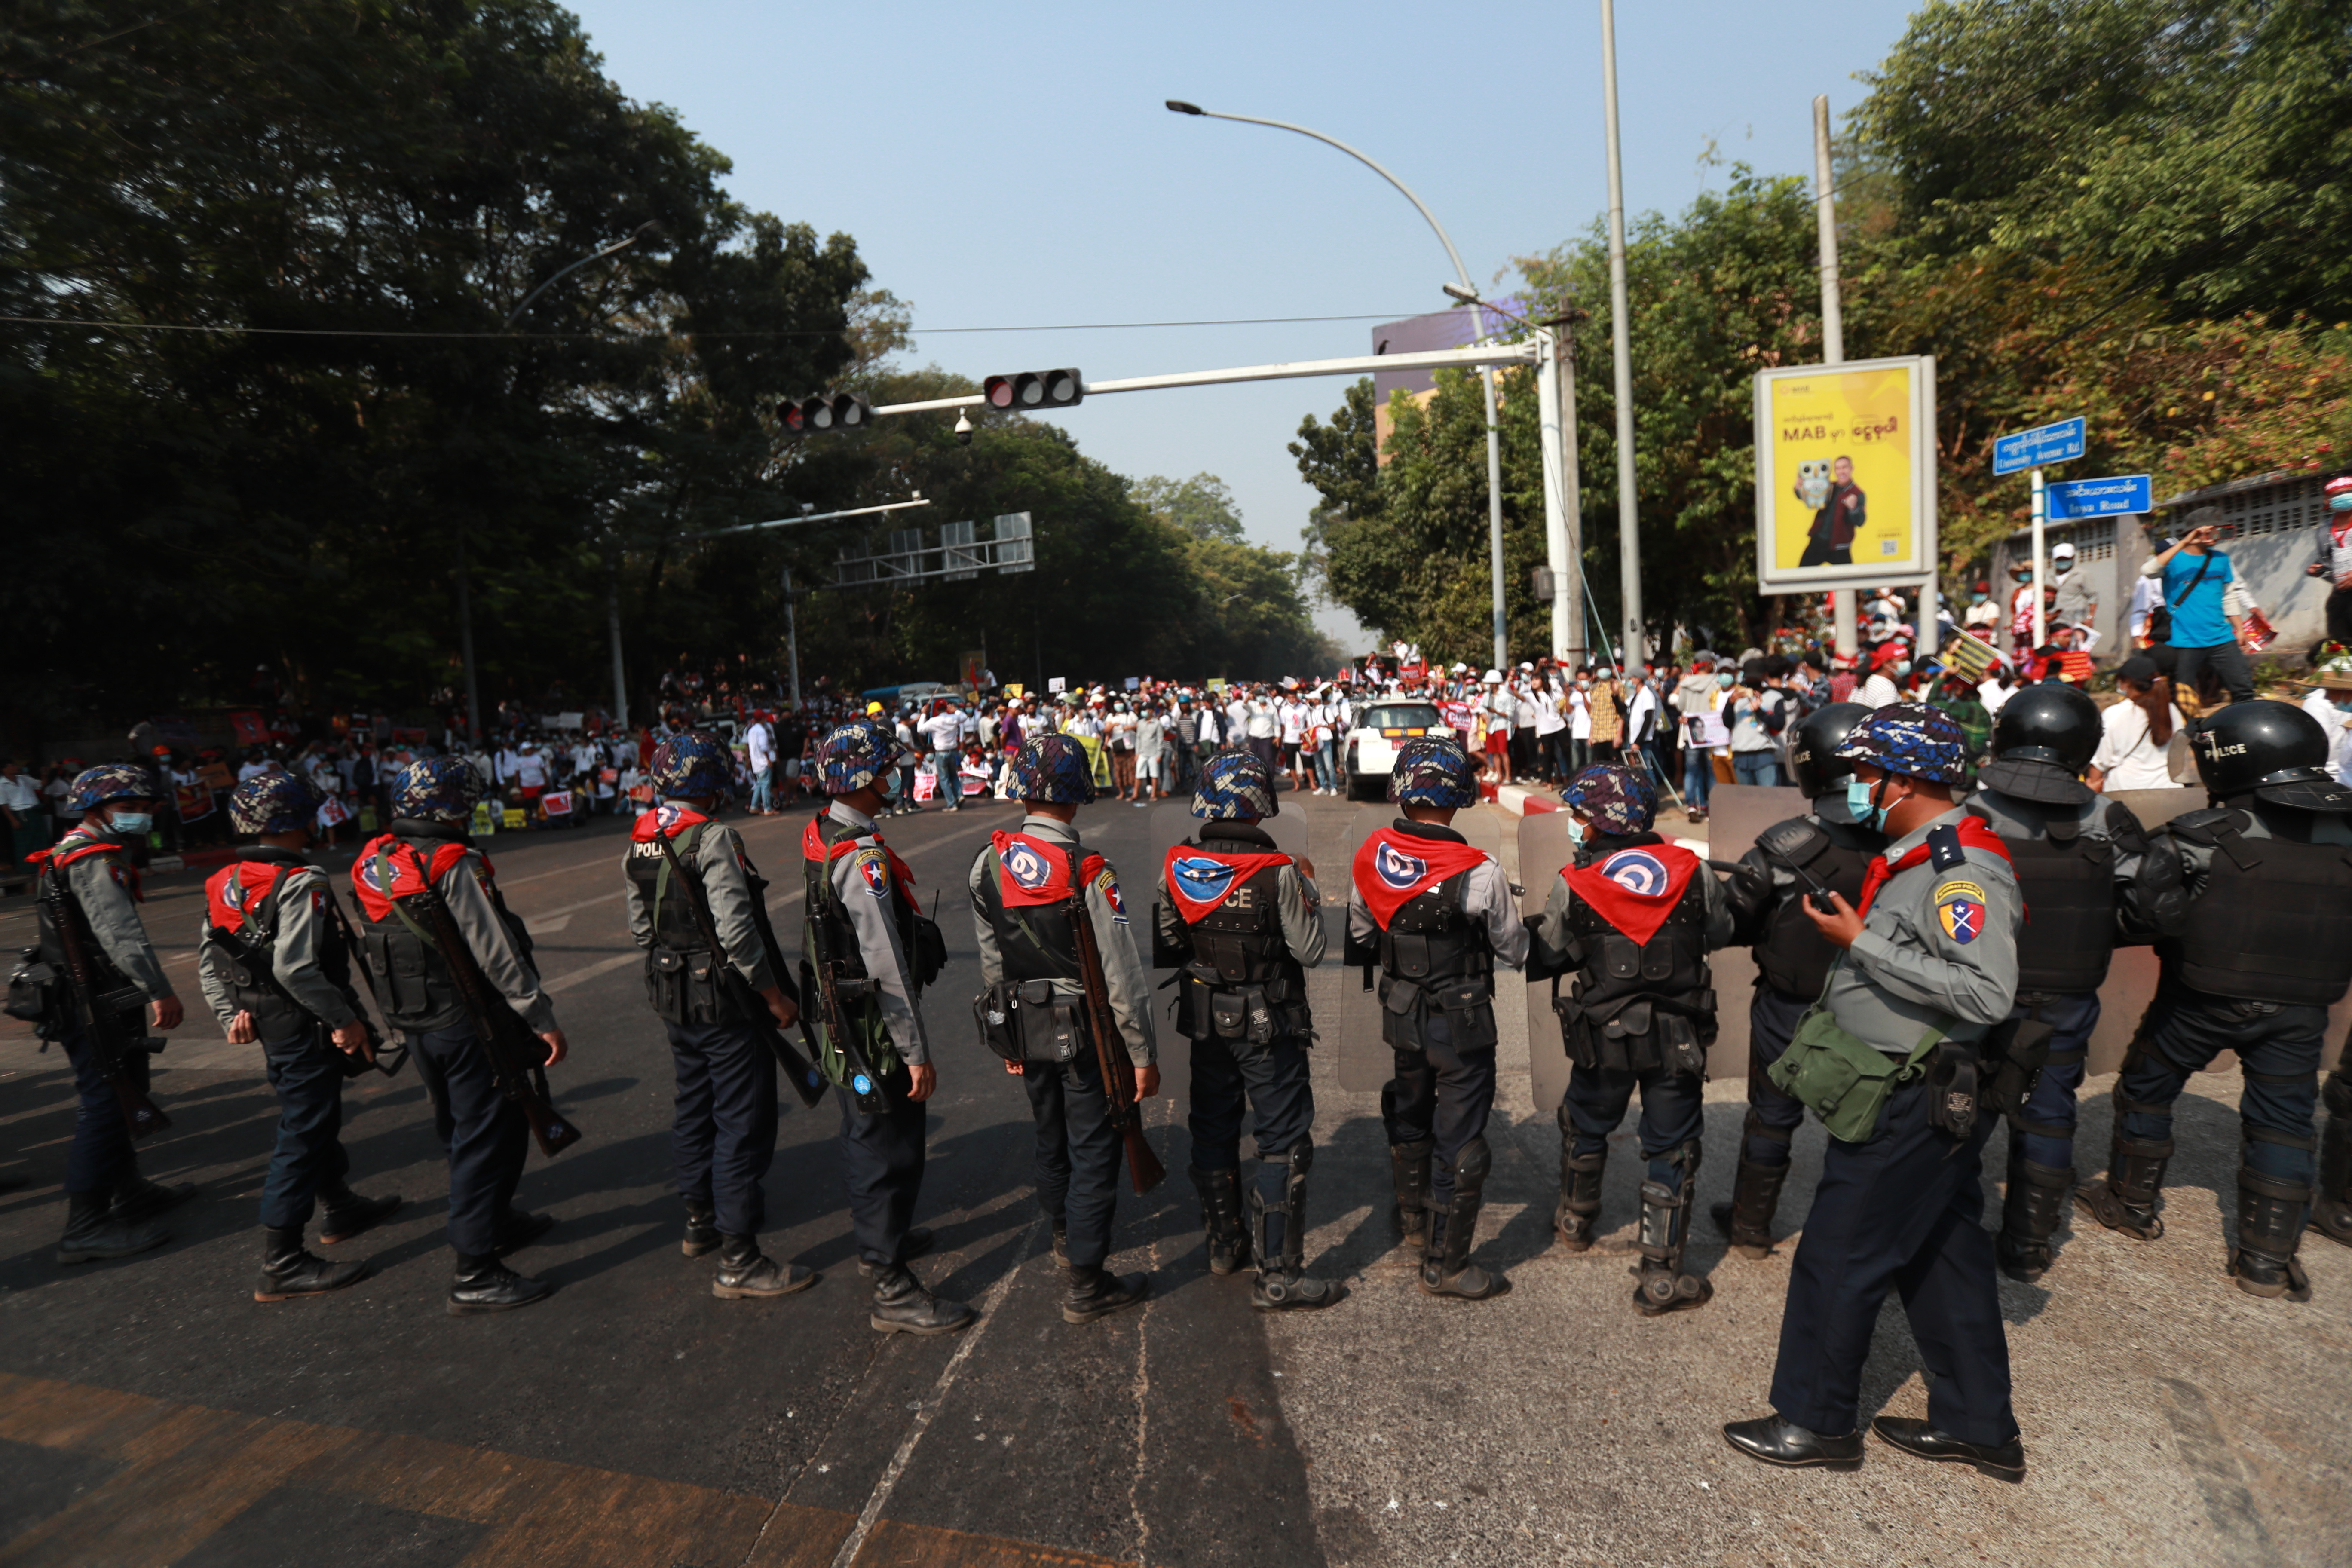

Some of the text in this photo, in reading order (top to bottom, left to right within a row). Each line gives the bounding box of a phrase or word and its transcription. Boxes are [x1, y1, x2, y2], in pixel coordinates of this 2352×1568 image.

[1783, 425, 1825, 441] MAB
[1998, 441, 2080, 469] University Avenue Rd
[2069, 499, 2129, 515] Inya Road
[1447, 711, 1470, 723] CDM
[2204, 743, 2247, 760] PLICE
[857, 851, 873, 864] MYANMAR
